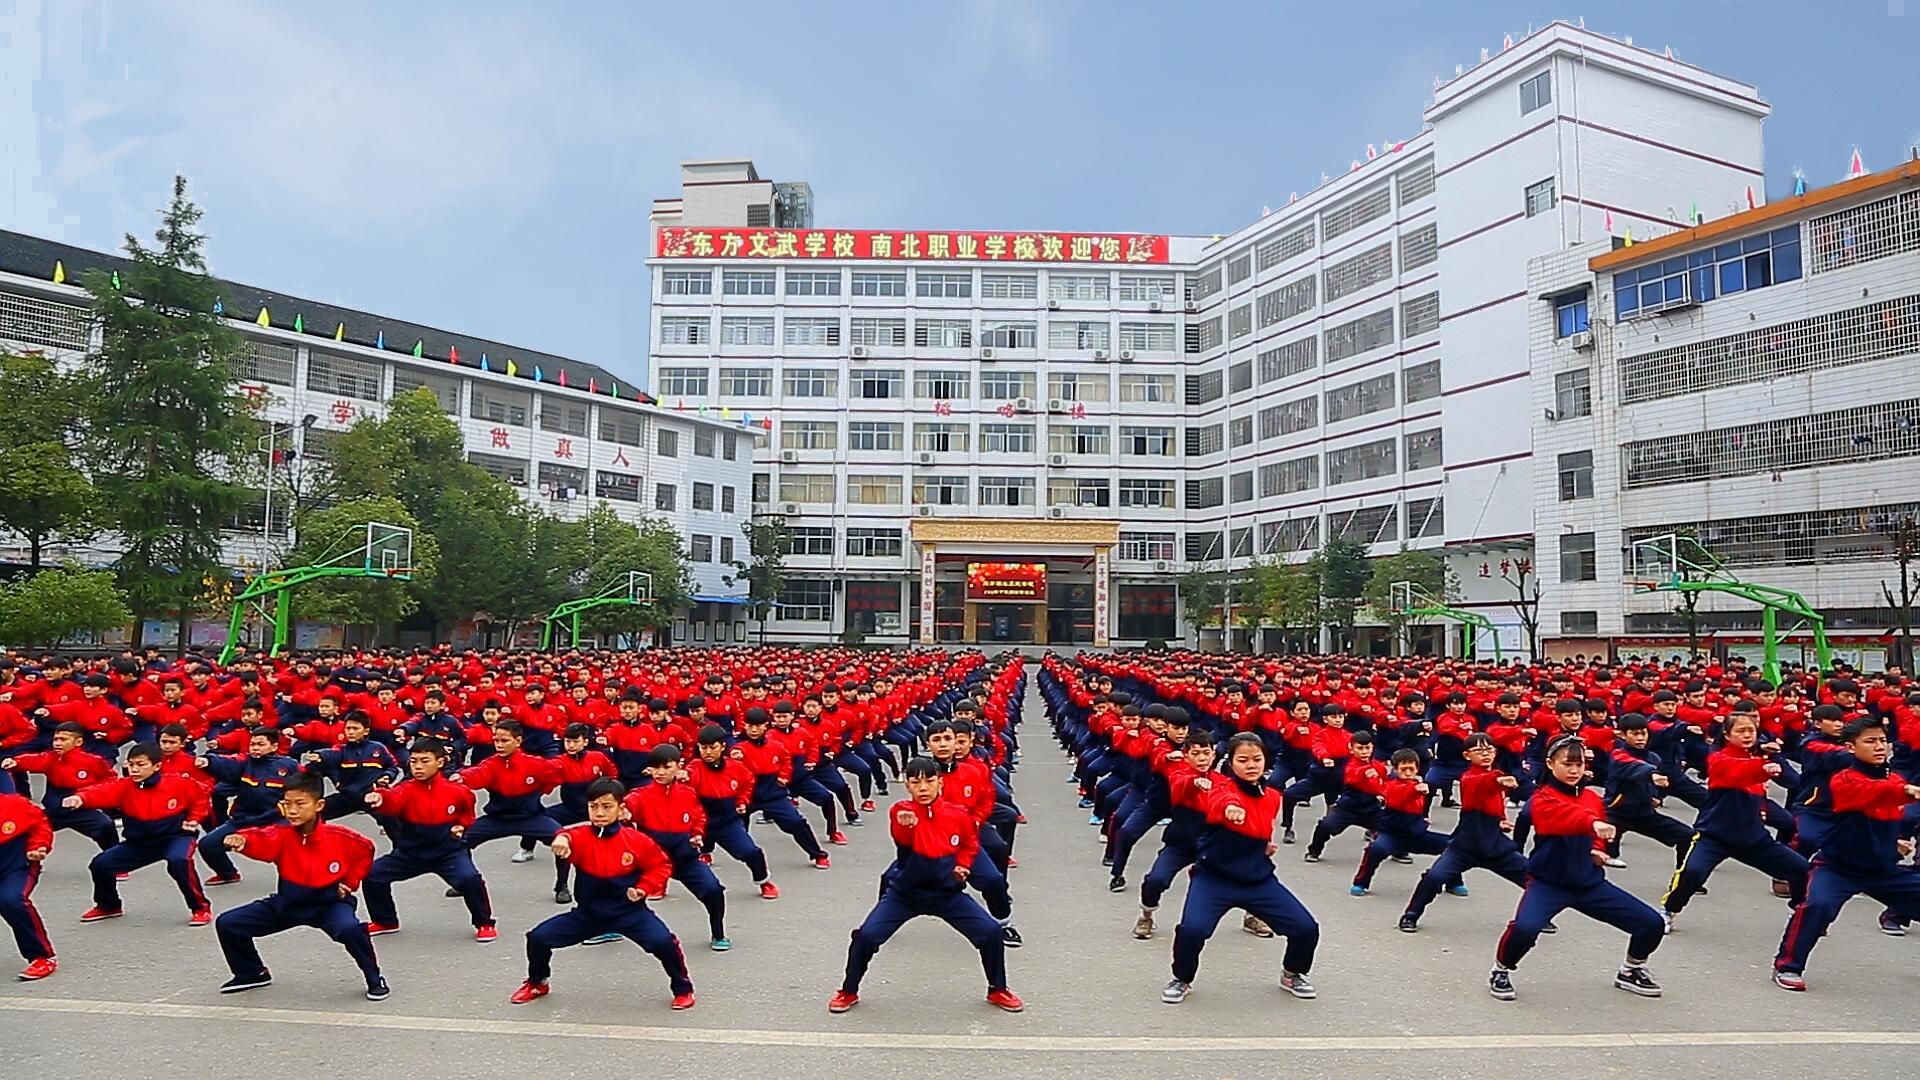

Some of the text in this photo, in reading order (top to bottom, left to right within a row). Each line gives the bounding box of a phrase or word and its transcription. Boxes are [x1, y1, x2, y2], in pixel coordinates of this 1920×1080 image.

[691, 231, 854, 258] 东方文武学校
